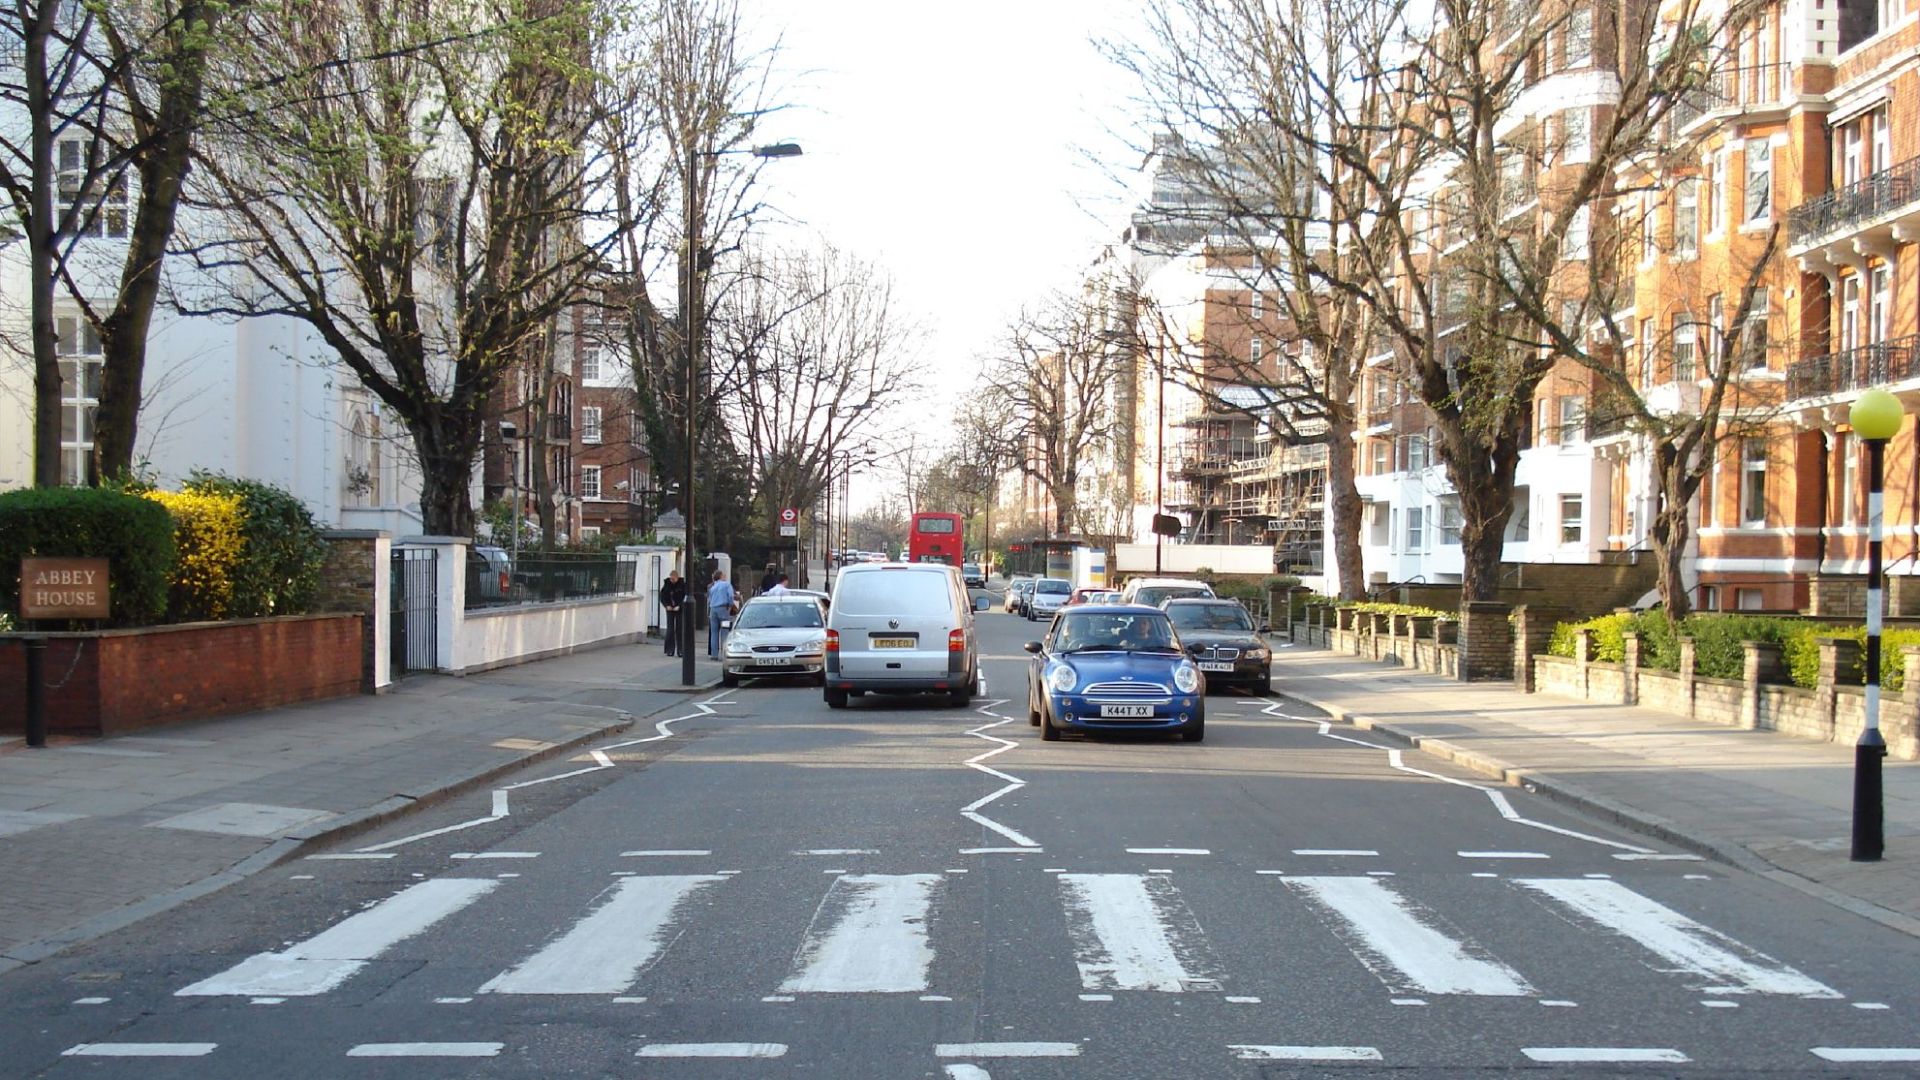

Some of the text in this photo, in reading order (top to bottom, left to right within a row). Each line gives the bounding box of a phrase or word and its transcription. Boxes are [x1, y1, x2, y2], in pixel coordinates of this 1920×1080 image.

[35, 570, 96, 585] ABBEY
[36, 591, 97, 606] HOUSE
[1107, 706, 1148, 716] K44T XX
